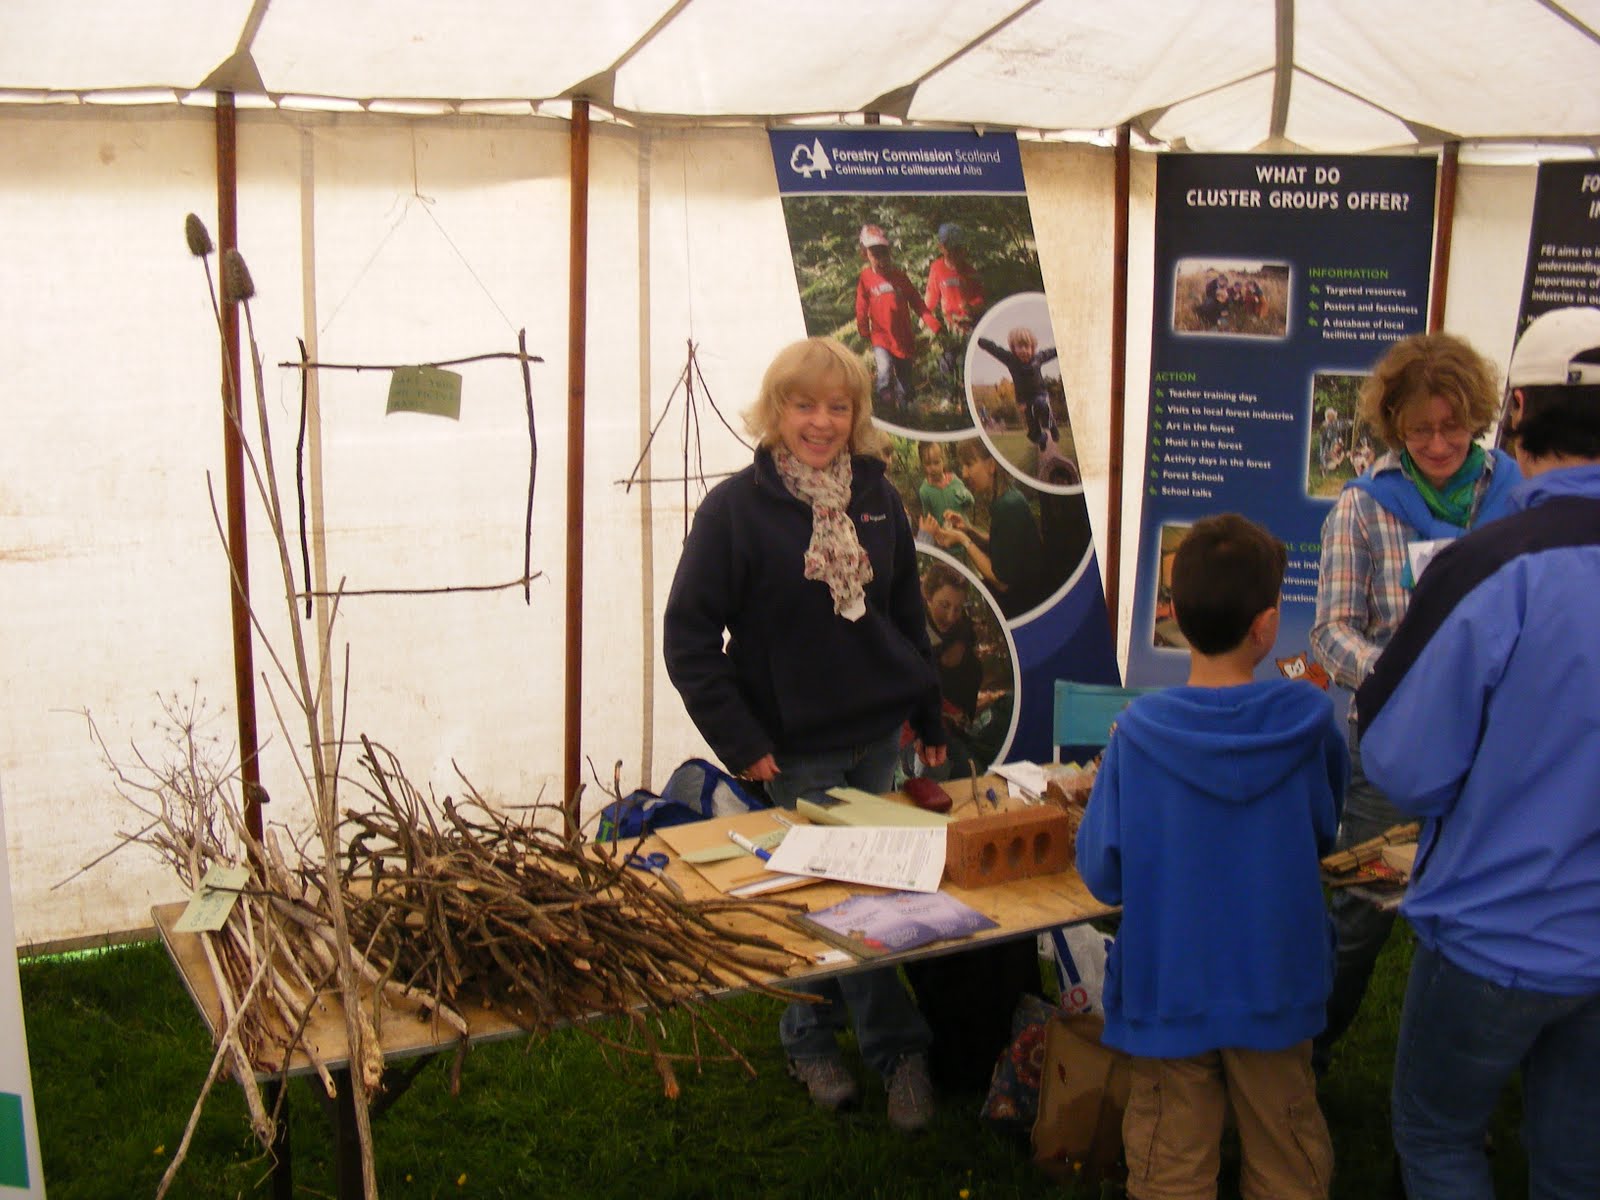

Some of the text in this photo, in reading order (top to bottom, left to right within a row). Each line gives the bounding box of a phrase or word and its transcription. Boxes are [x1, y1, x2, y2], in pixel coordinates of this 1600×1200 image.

[832, 148, 1001, 164] Forestry Commission Scotland
[886, 166, 899, 176] na
[963, 164, 982, 176] Alba
[1256, 166, 1340, 184] WHAT DO
[1186, 189, 1409, 211] CLUSTER GROUPS OFFER?
[1581, 246, 1592, 257] to
[1308, 267, 1389, 279] INFORMATION
[1325, 284, 1407, 297] Targeted resources
[1576, 291, 1586, 303] in
[1324, 301, 1418, 315] Posters and factsheets
[1323, 318, 1404, 330] A database of local
[1322, 330, 1357, 340] facilities
[1360, 331, 1376, 340] and
[1155, 372, 1196, 382] ACTION
[1168, 388, 1258, 404] Teacher training days
[1167, 405, 1294, 421] Visits to local forest industries
[1166, 421, 1235, 434] Art in the forest
[1165, 437, 1243, 451] Music in the forest
[1163, 454, 1271, 470] Activity days in the forest
[1162, 469, 1224, 483] Forest Schools
[1161, 486, 1212, 498] School talks
